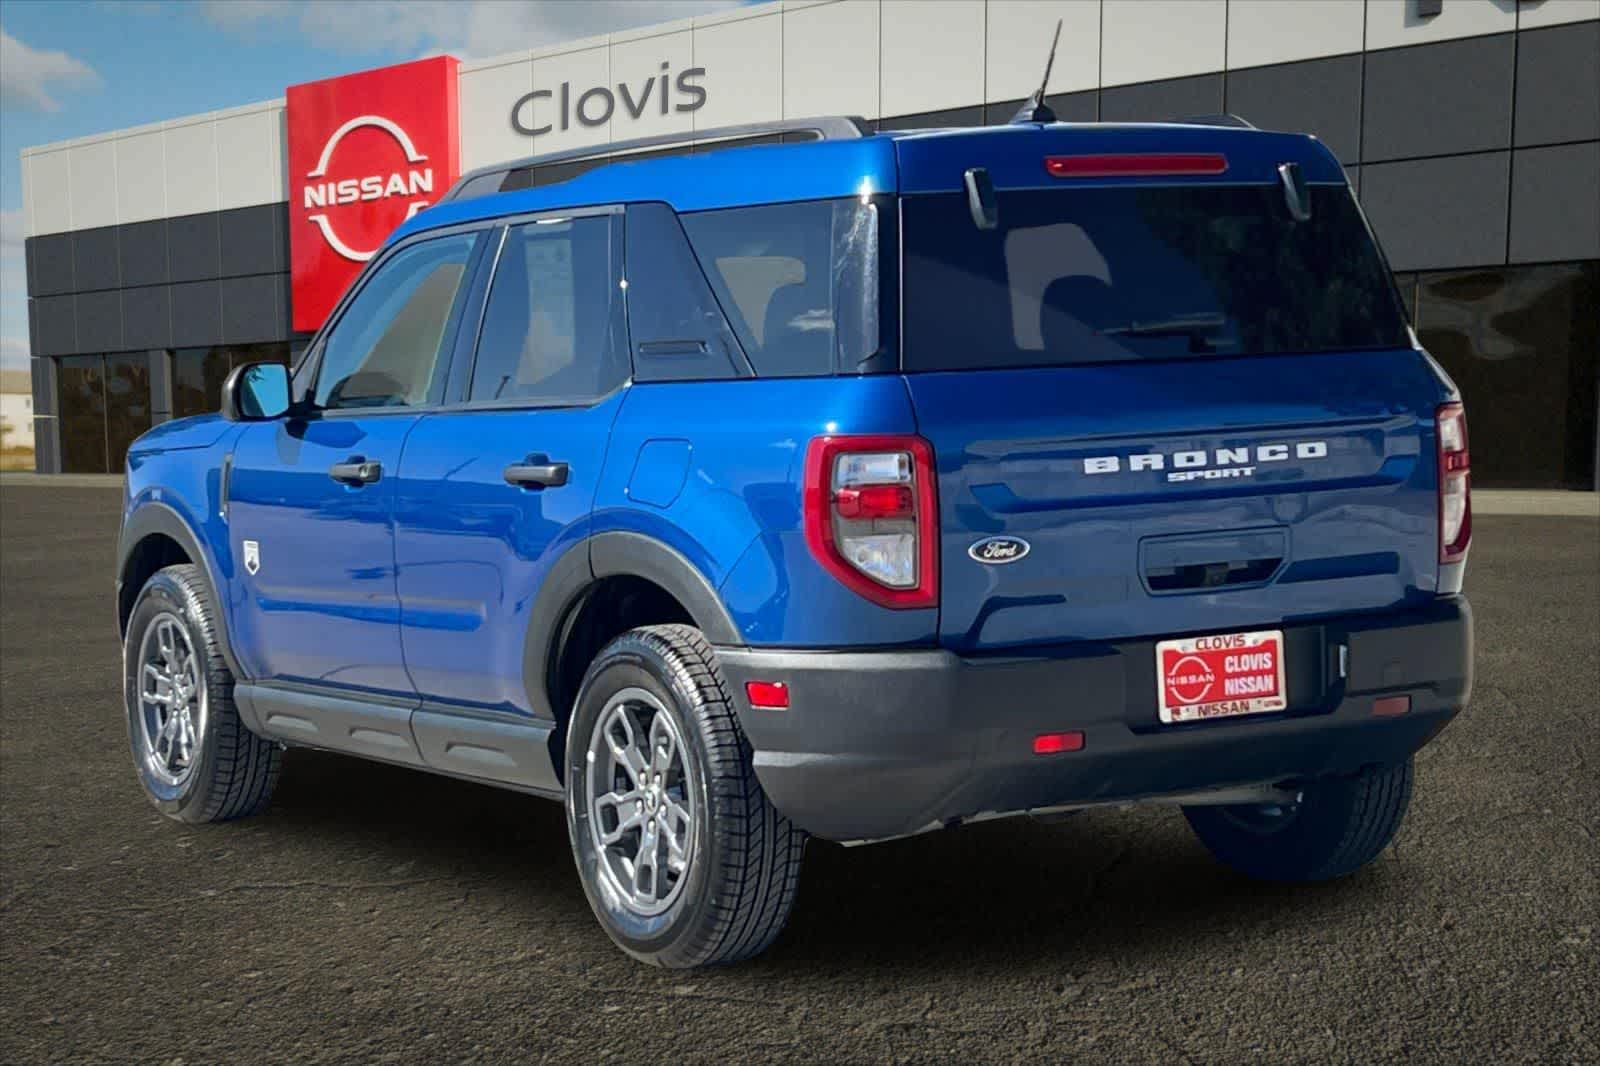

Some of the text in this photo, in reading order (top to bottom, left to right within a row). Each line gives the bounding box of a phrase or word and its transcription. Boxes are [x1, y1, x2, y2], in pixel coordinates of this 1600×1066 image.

[511, 62, 707, 136] Clovis
[304, 168, 433, 208] NISSAN
[1083, 441, 1327, 474] BRONCO
[1167, 466, 1256, 482] SPORT
[983, 541, 1017, 558] Ford
[1195, 635, 1246, 650] CLOVIS
[1225, 653, 1272, 673] CLOVIS
[1167, 674, 1215, 686] NISSAN
[1225, 675, 1274, 696] NISSAN
[1198, 701, 1250, 716] NISSAN
